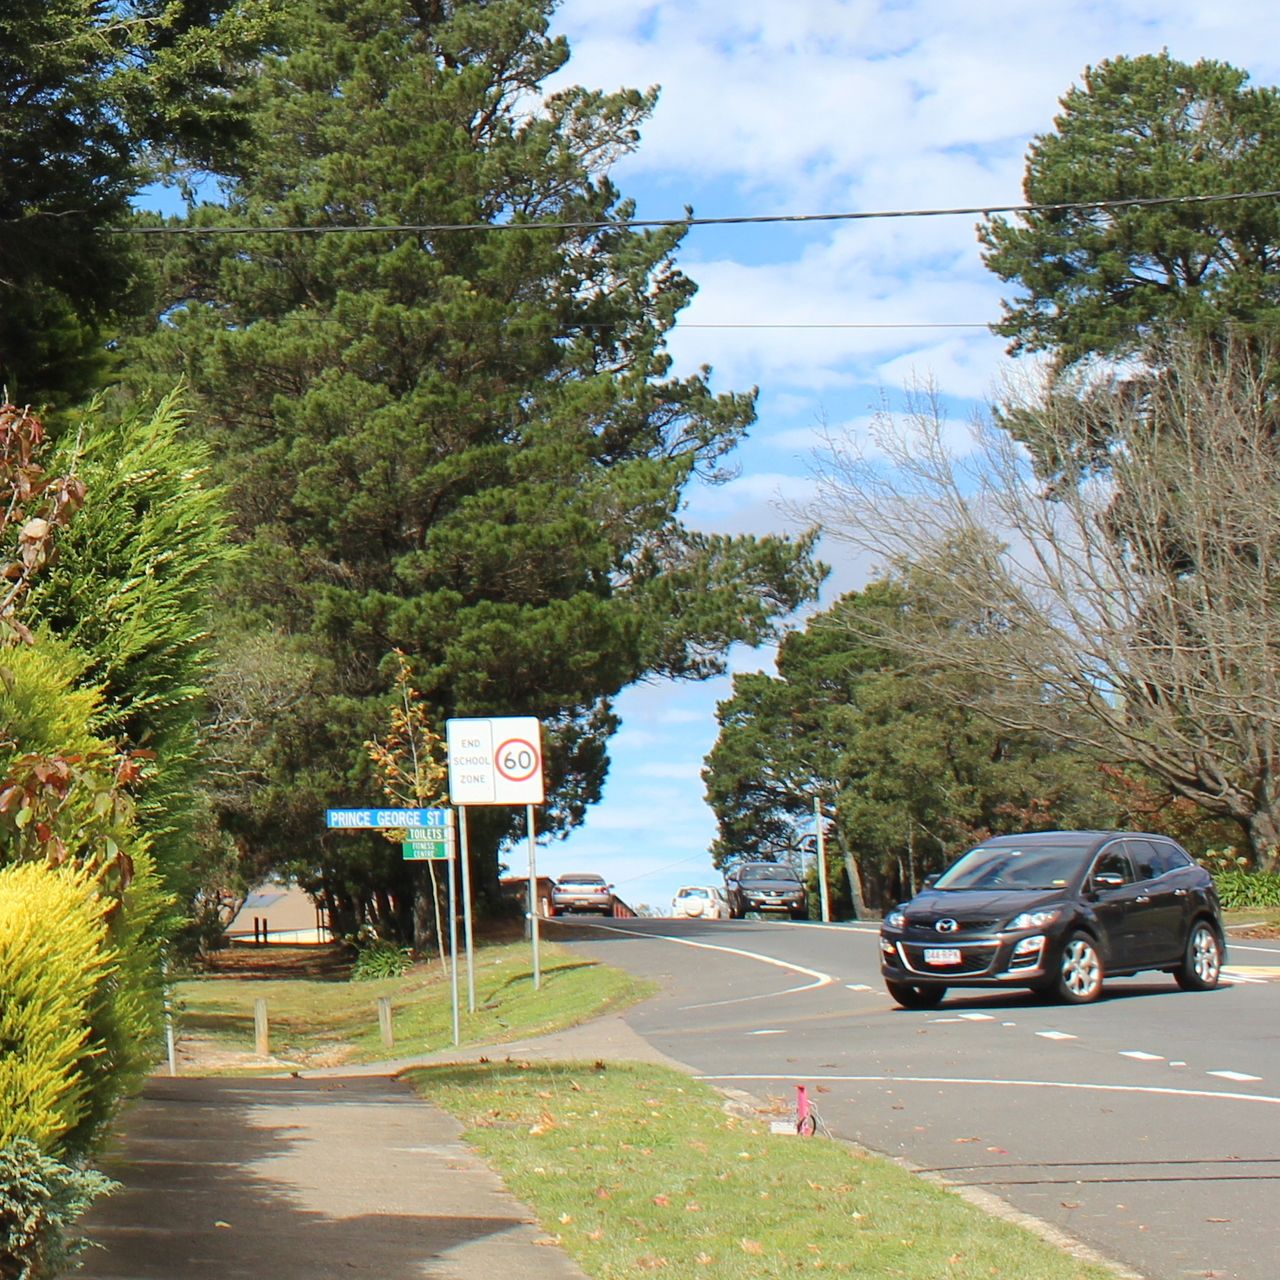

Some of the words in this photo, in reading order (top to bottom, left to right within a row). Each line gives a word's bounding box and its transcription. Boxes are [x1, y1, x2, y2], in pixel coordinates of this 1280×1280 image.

[461, 739, 481, 749] END
[453, 756, 491, 767] SCHOOL
[504, 750, 532, 770] 60
[460, 774, 487, 785] ZONE
[330, 811, 372, 826] PRINCE
[376, 811, 421, 826] GEORGE
[426, 811, 441, 826] ST
[409, 828, 442, 840] TOILETS
